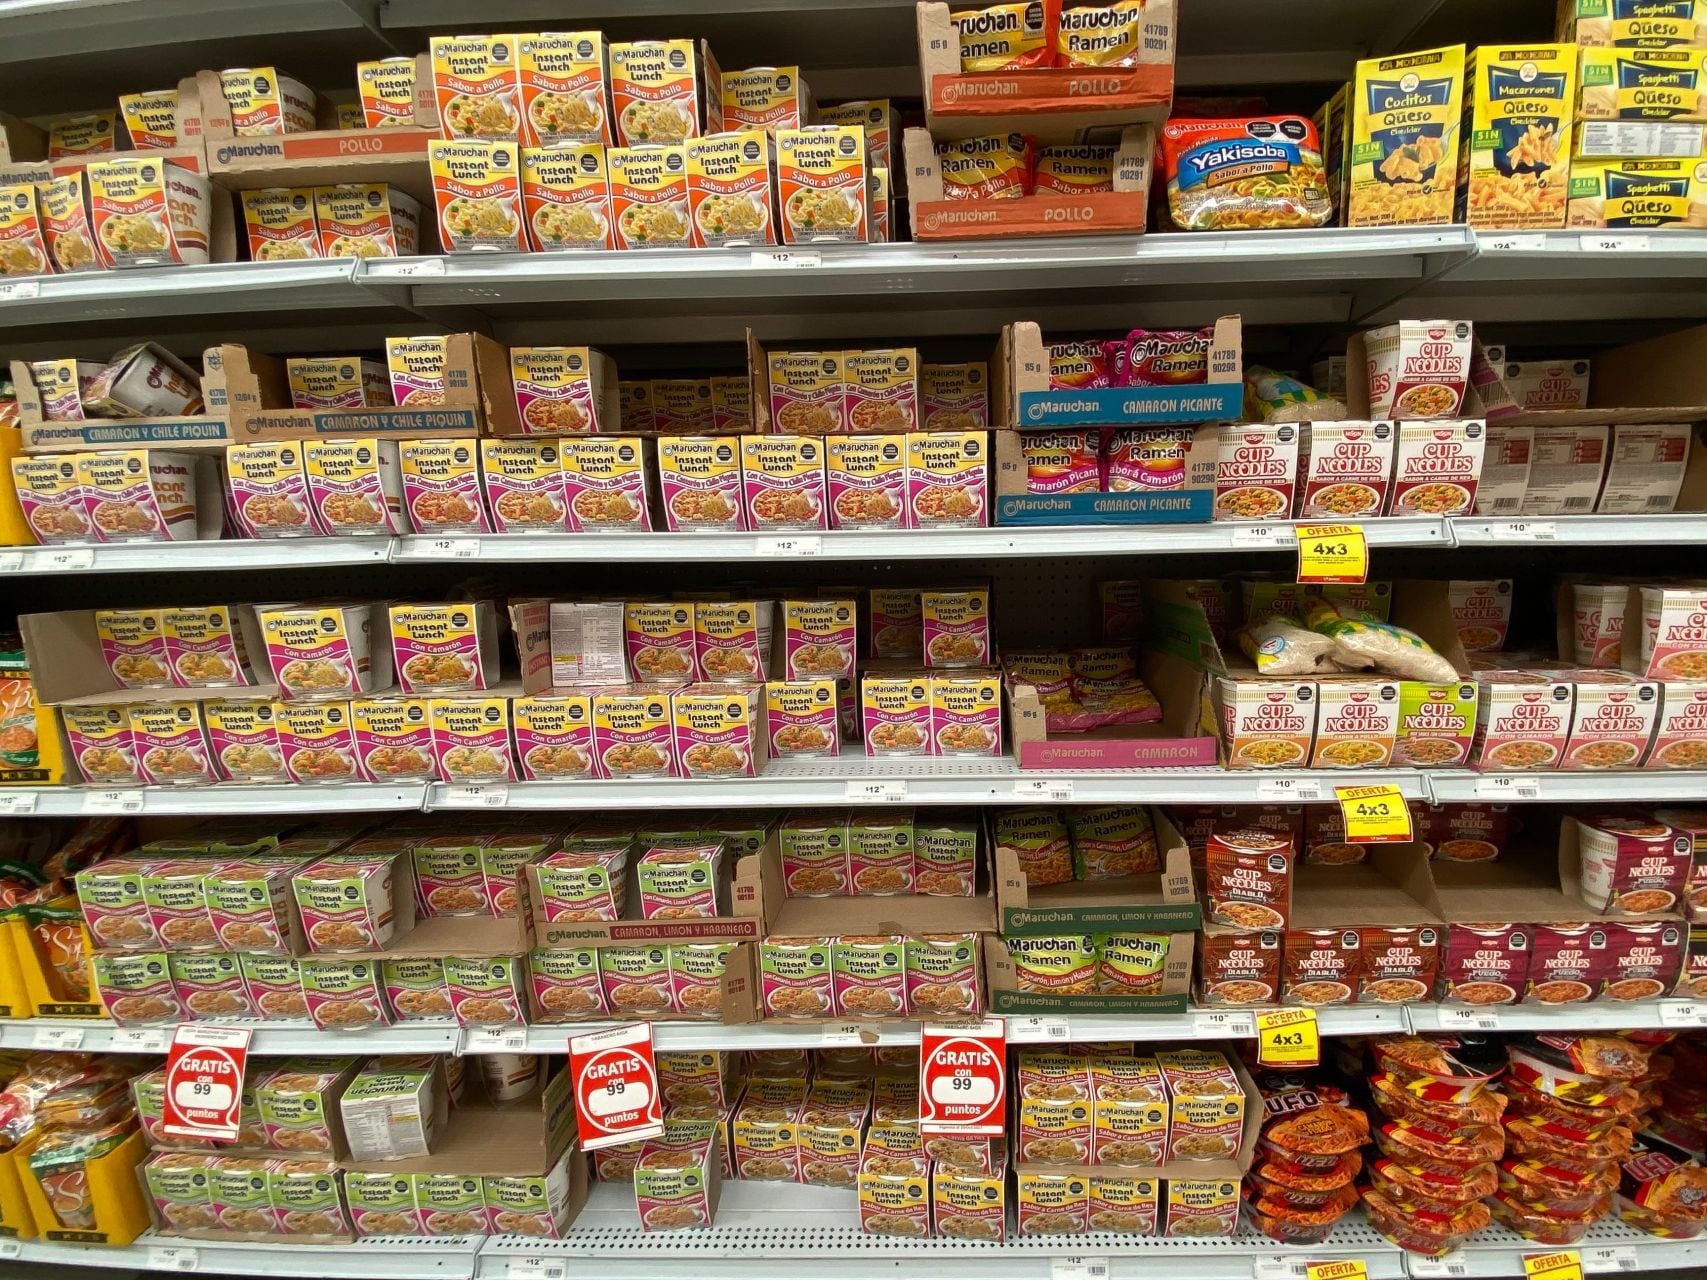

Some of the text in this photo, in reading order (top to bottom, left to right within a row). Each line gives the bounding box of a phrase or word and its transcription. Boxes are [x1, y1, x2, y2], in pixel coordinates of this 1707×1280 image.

[1633, 5, 1675, 17] Spaghetti
[1060, 6, 1138, 30] Maruchan
[1629, 22, 1678, 35] Queso
[1069, 31, 1129, 51] Ramen
[445, 43, 487, 53] Maruchan
[448, 56, 488, 66] Instant
[453, 66, 485, 75] Lunch
[448, 78, 475, 93] Sabor
[483, 78, 505, 91] Pollo
[1638, 74, 1680, 86] Spaghetti
[955, 81, 1019, 95] Maruchan
[1069, 79, 1121, 96] POLLO
[1499, 85, 1555, 96] Macarrones
[1384, 94, 1432, 109] Coditos
[1634, 91, 1681, 105] Queso
[1503, 101, 1548, 114] Queso
[1384, 110, 1432, 126] Queso
[791, 135, 835, 145] Maruchan
[1477, 130, 1499, 140] SIN
[228, 143, 282, 156] Maruchan
[339, 138, 383, 153] POLLO
[1358, 143, 1380, 151] SIN
[794, 149, 835, 158] Instant
[1192, 146, 1286, 170] Yakisoba
[799, 158, 831, 168] Lunch
[941, 157, 995, 173] Ramen
[1053, 162, 1107, 175] Ramen
[1120, 157, 1144, 167] 41789
[1120, 170, 1143, 181] 90291
[1215, 168, 1241, 180] Sabor
[1250, 164, 1273, 173] Pollo
[792, 171, 819, 187] Sabor
[828, 171, 850, 185] Pollo
[1575, 178, 1597, 187] SIN
[1627, 183, 1670, 194] Spaghetti
[1045, 206, 1094, 221] POLLO
[1622, 200, 1672, 214] Queso
[937, 210, 997, 223] Maruchan
[1212, 350, 1236, 360] 41789
[1421, 343, 1452, 358] CUP
[1025, 362, 1041, 373] 85 g
[1152, 358, 1207, 372] Ramen
[1406, 357, 1462, 374] NOODLES
[1043, 400, 1099, 413] Maruchan
[1123, 398, 1223, 414] CAMARON PICANTE
[257, 416, 313, 428] Maruchan
[321, 412, 466, 430] CAMARON Y CHILE PIQUIN
[89, 424, 220, 441] CAMARON Y CHILE PIQUIN
[755, 443, 796, 452] Maruchan
[1130, 447, 1185, 460] Ramen
[1423, 443, 1461, 459] CUP
[758, 454, 796, 464] Instant
[1235, 447, 1274, 463] CUP
[762, 462, 793, 471] Lunch
[1192, 462, 1215, 472] 41789
[1218, 460, 1286, 478] NOODLES
[1405, 456, 1472, 474] NOODLES
[1141, 471, 1183, 488] Camarón
[1016, 499, 1072, 511] Maruchan
[1094, 497, 1191, 512] CAMARON PICANTE
[1306, 525, 1353, 536] OFERTA
[1313, 543, 1348, 556] 4x3
[276, 618, 317, 627] Maruchan
[279, 629, 318, 637] Instant
[285, 637, 316, 645] Lunch
[284, 645, 334, 658] Con Camarón
[1021, 666, 1060, 676] Ramen
[1258, 704, 1294, 718] CUP
[1419, 702, 1455, 717] CUP
[1513, 705, 1549, 719] CUP
[1242, 717, 1304, 732] NOODLES
[1403, 715, 1466, 730] NOODLES
[1495, 716, 1560, 732] NOODLES
[1052, 748, 1103, 758] Maruchan
[1134, 747, 1198, 758] CAMARON
[1345, 786, 1390, 799] OFERTA
[1356, 803, 1390, 816] 4x3
[924, 836, 971, 848] Maruchan
[1641, 857, 1667, 868] CUP
[650, 870, 687, 878] Maruchan
[1233, 869, 1261, 880] CUP
[1628, 866, 1675, 877] NOODLES
[653, 879, 688, 887] Instant
[1222, 877, 1272, 892] NOODLES
[657, 886, 685, 894] Lunch
[1232, 888, 1264, 898] DIABLO
[1023, 912, 1073, 922] Maruchan
[1122, 913, 1145, 921] LIMON
[1154, 911, 1194, 920] HABANERO
[557, 929, 608, 940] Maruchan
[664, 925, 692, 937] LIMON
[695, 926, 700, 935] Y
[703, 924, 752, 935] HABANERO
[1009, 939, 1076, 952] Maruchan
[1022, 955, 1071, 965] Ramen
[1104, 950, 1153, 967] Ramen
[1229, 950, 1255, 960] CUP
[1475, 950, 1502, 960] CUP
[1218, 959, 1264, 969] NOODLES
[1462, 959, 1511, 970] NOODLES
[1266, 1010, 1307, 1026] OFERTA
[1273, 1032, 1303, 1046] 4x3
[936, 1051, 991, 1066] GRATIS
[181, 1058, 231, 1074] GRATIS
[587, 1058, 641, 1080] GRATIS
[955, 1068, 972, 1076] con
[197, 1075, 213, 1083] con
[953, 1078, 972, 1090] 99
[194, 1083, 211, 1095] 99
[607, 1082, 625, 1096] 99
[187, 1109, 218, 1119] puntos
[945, 1105, 981, 1116] puntos
[1186, 1110, 1220, 1118] Instant
[604, 1111, 639, 1128] puntos
[1176, 1122, 1194, 1132] Sabor
[1533, 1254, 1572, 1269] OFERTA
[1316, 1262, 1357, 1277] OFERTA
